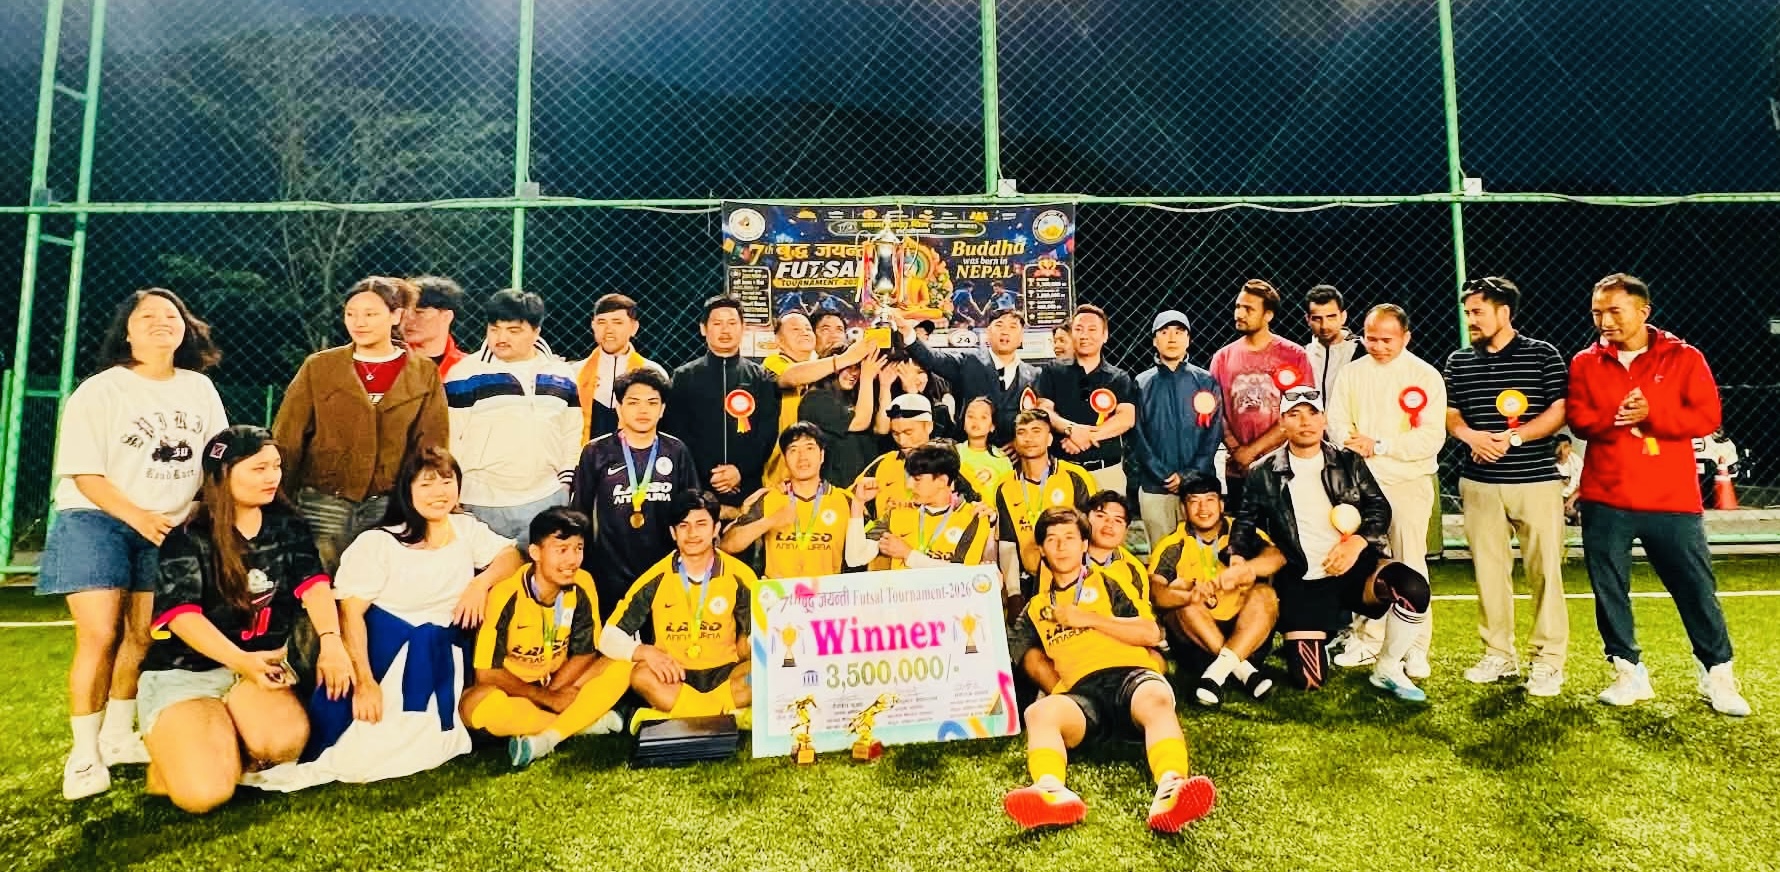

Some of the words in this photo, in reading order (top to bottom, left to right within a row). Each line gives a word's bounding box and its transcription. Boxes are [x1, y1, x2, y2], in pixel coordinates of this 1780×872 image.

[951, 240, 1026, 257] Buddha
[963, 257, 979, 265] was
[956, 264, 1014, 279] NEPAL
[781, 279, 839, 287] TOURNAMENT
[853, 587, 883, 606] Futsal
[809, 616, 946, 656] Winner
[826, 654, 960, 691] 3,500,000/-
